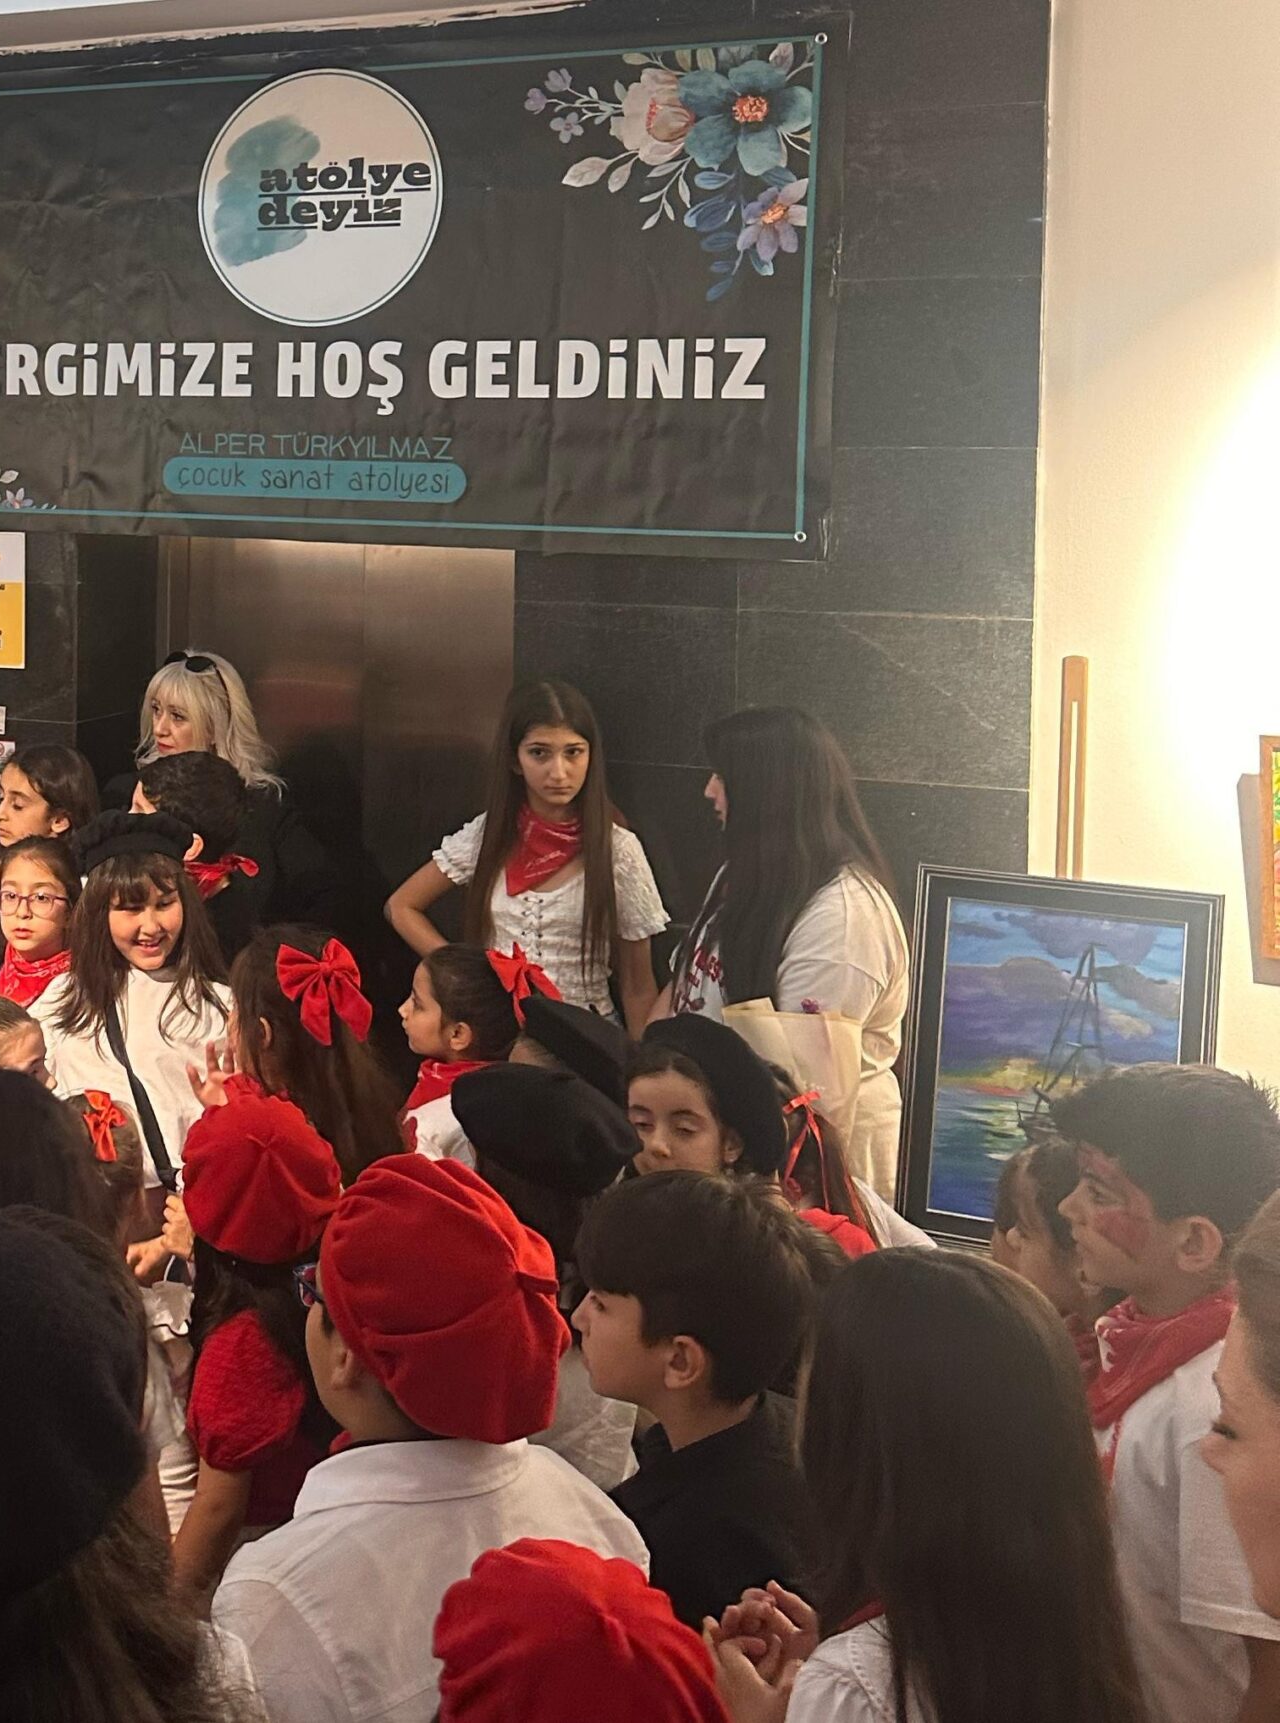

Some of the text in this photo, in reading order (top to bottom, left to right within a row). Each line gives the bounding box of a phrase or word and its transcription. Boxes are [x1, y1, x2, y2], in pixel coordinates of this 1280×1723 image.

[259, 157, 432, 196] atölye
[258, 194, 402, 232] deyiz
[277, 340, 404, 416] HOŞ
[179, 431, 454, 461] ALPER TÜRKYILMAZ
[178, 461, 451, 499] çocuk sanat atölyesi
